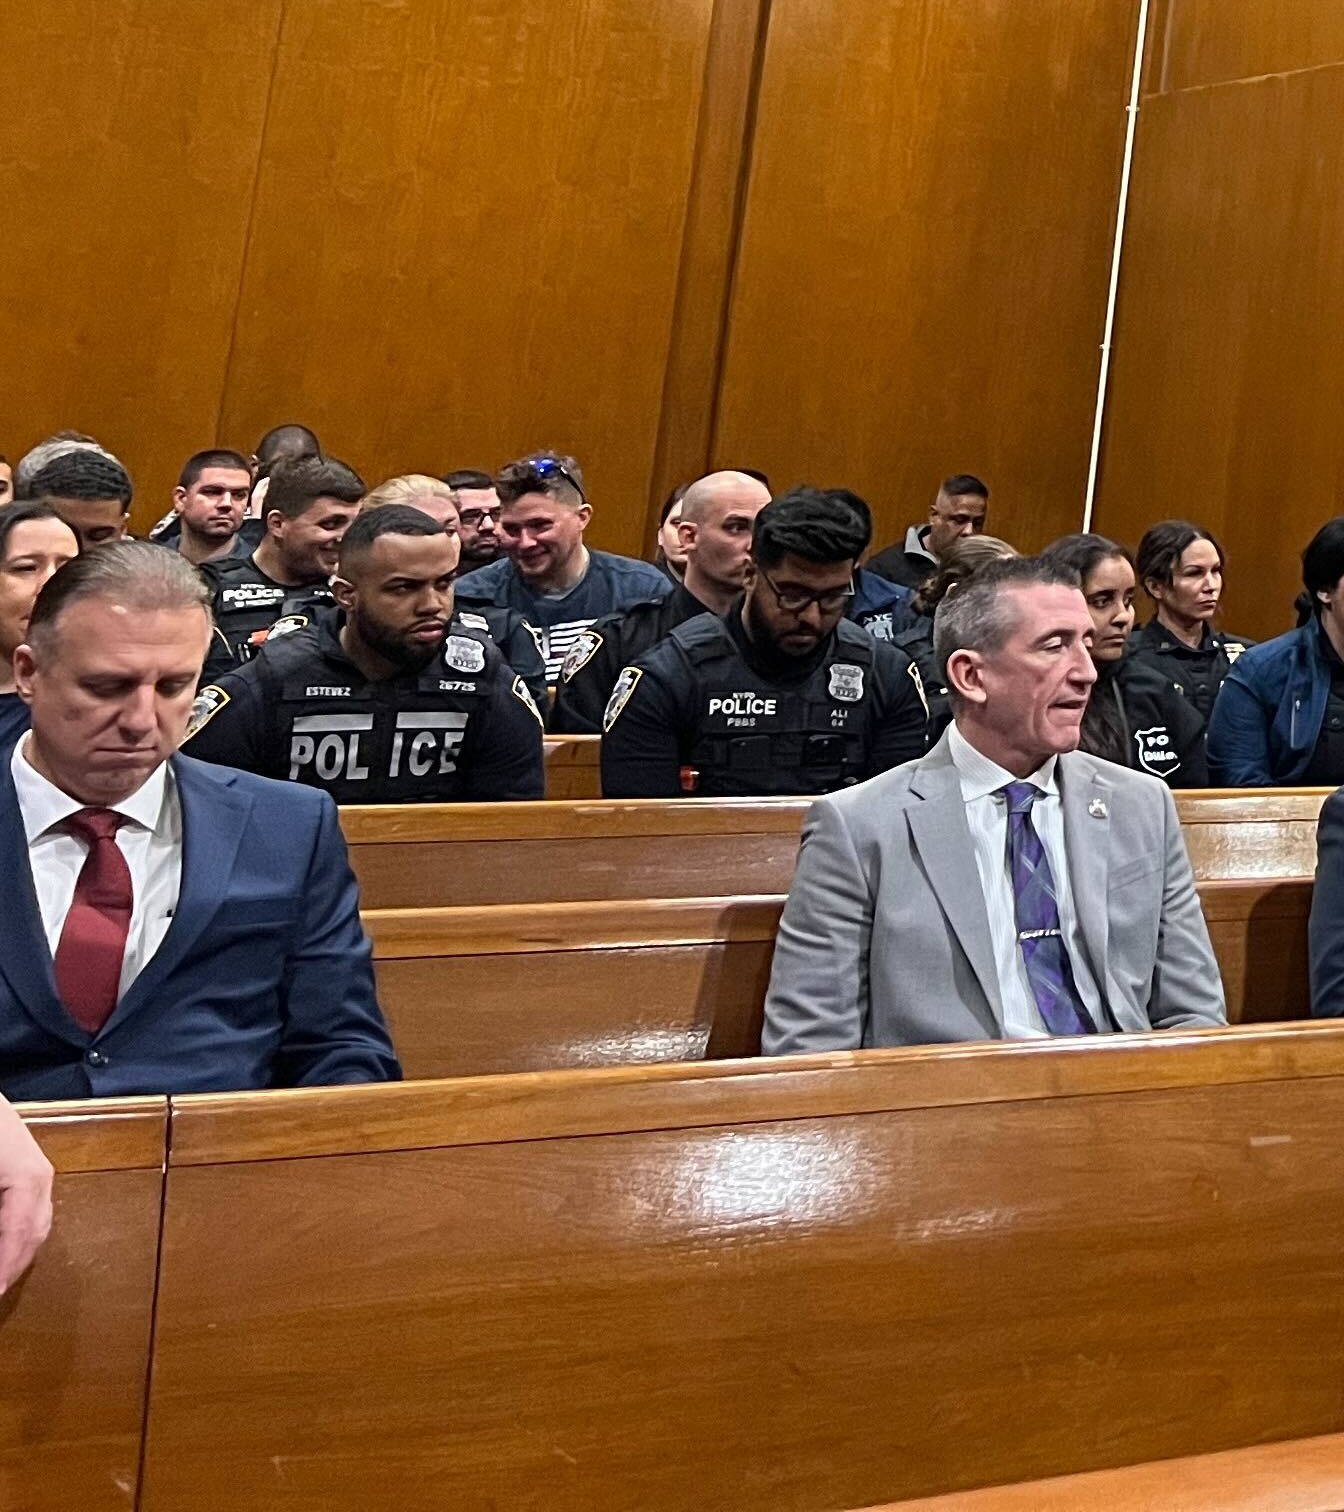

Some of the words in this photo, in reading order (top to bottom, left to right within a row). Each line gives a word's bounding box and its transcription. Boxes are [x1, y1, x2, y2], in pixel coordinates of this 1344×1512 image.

[222, 588, 285, 602] POLICE
[305, 686, 351, 697] ESTEVEZ
[708, 698, 777, 716] POLICE
[1146, 734, 1169, 747] PO
